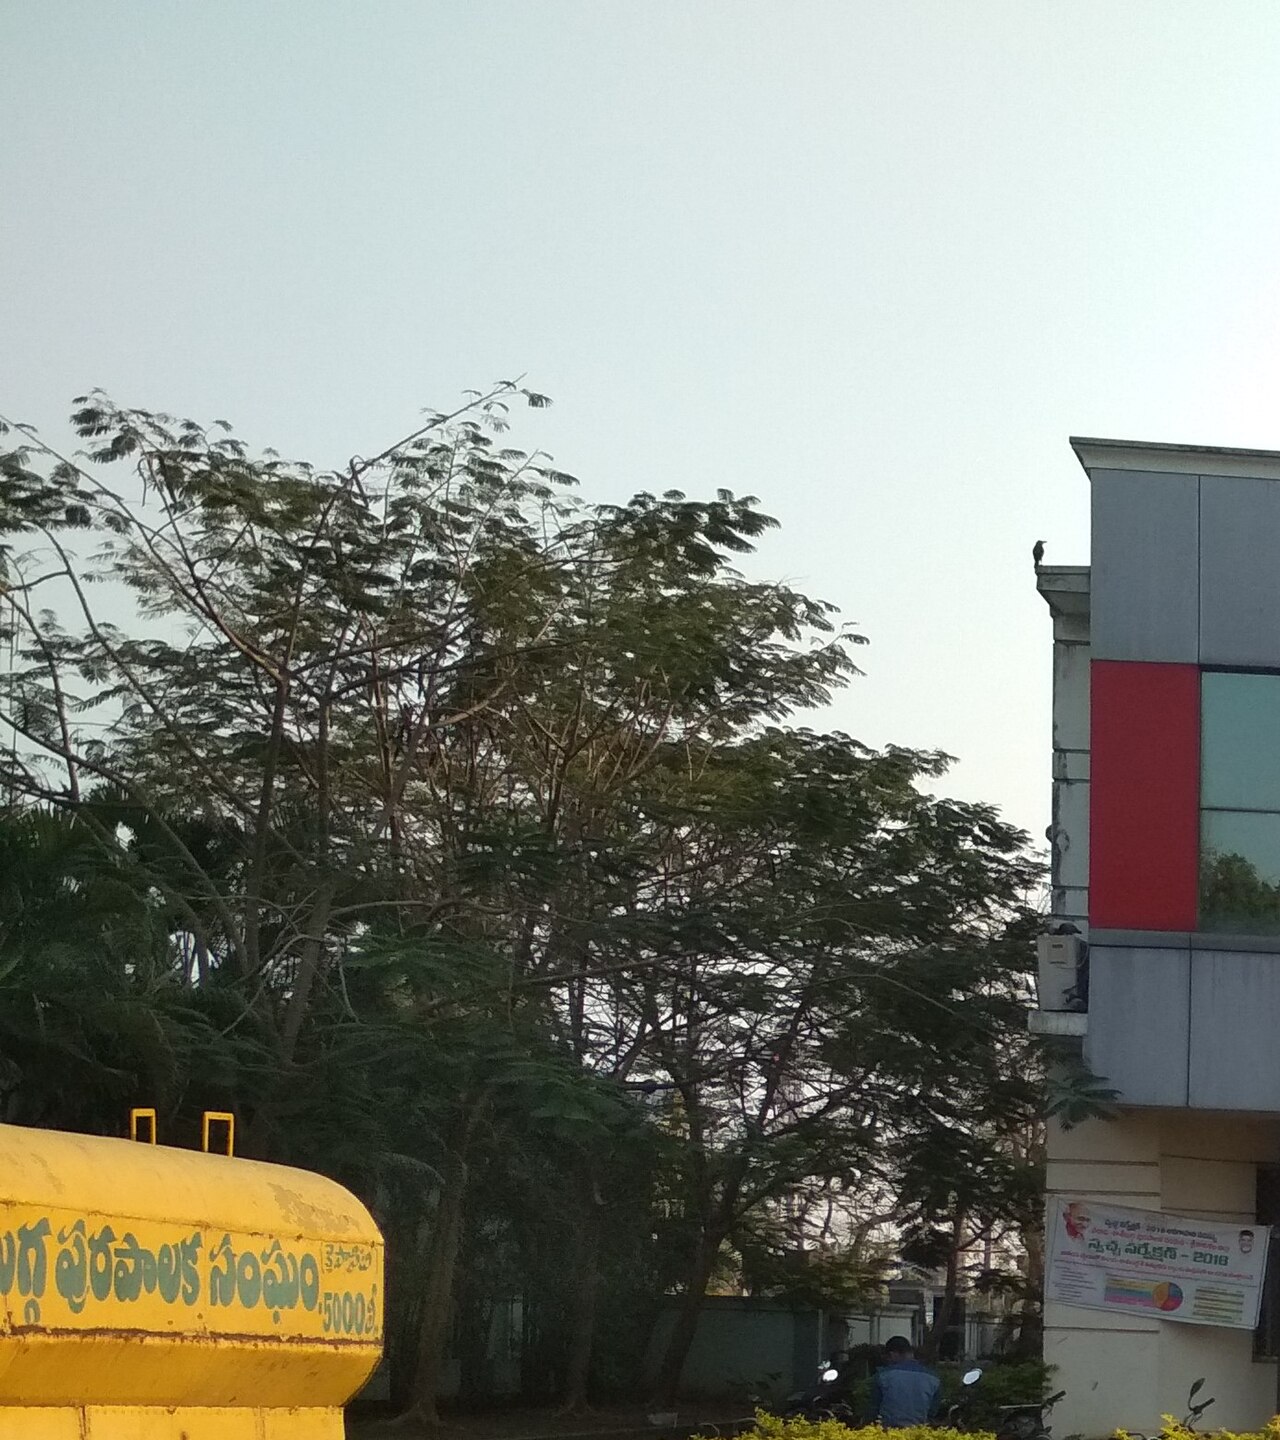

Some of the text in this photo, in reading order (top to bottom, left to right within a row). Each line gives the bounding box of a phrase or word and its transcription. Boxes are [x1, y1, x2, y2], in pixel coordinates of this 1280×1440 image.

[55, 1217, 204, 1315] పురపాలక
[209, 1232, 320, 1326] సంఘం
[1192, 1251, 1230, 1267] 2018
